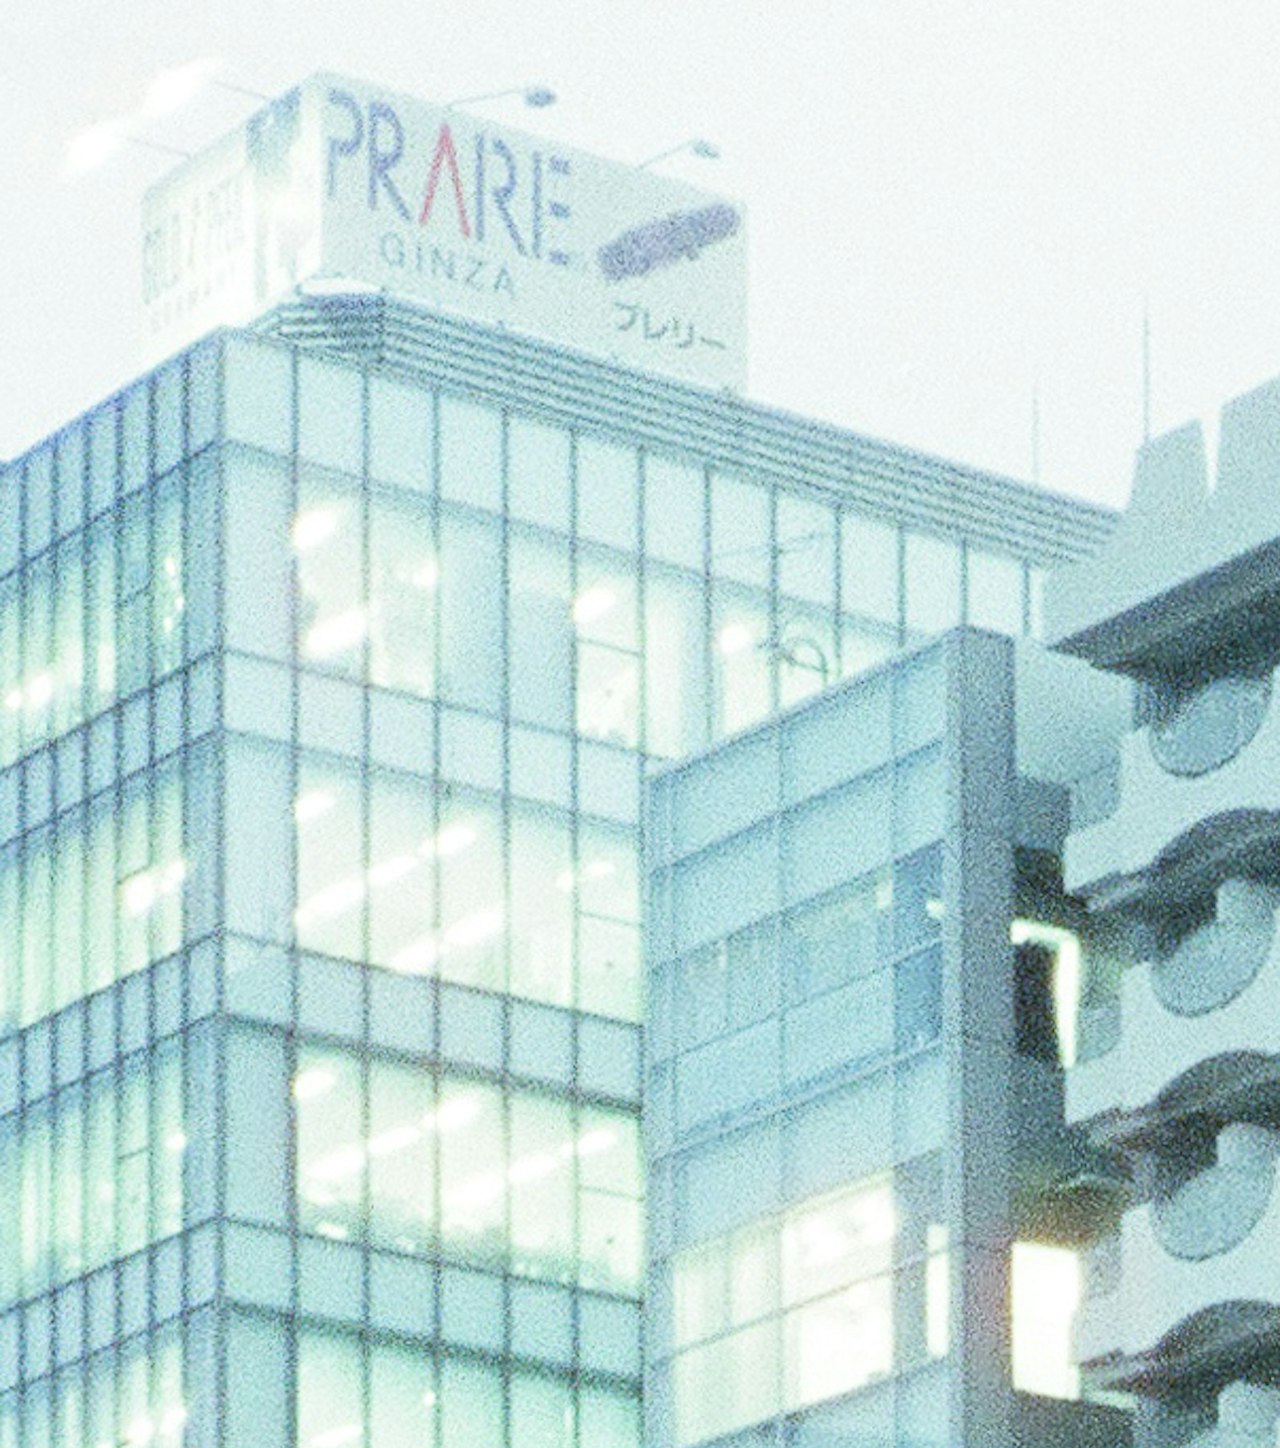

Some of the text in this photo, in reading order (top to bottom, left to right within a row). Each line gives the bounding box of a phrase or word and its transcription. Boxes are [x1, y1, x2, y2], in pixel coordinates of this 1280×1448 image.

[379, 232, 518, 297] GINZA
[613, 300, 728, 353] プレリー
